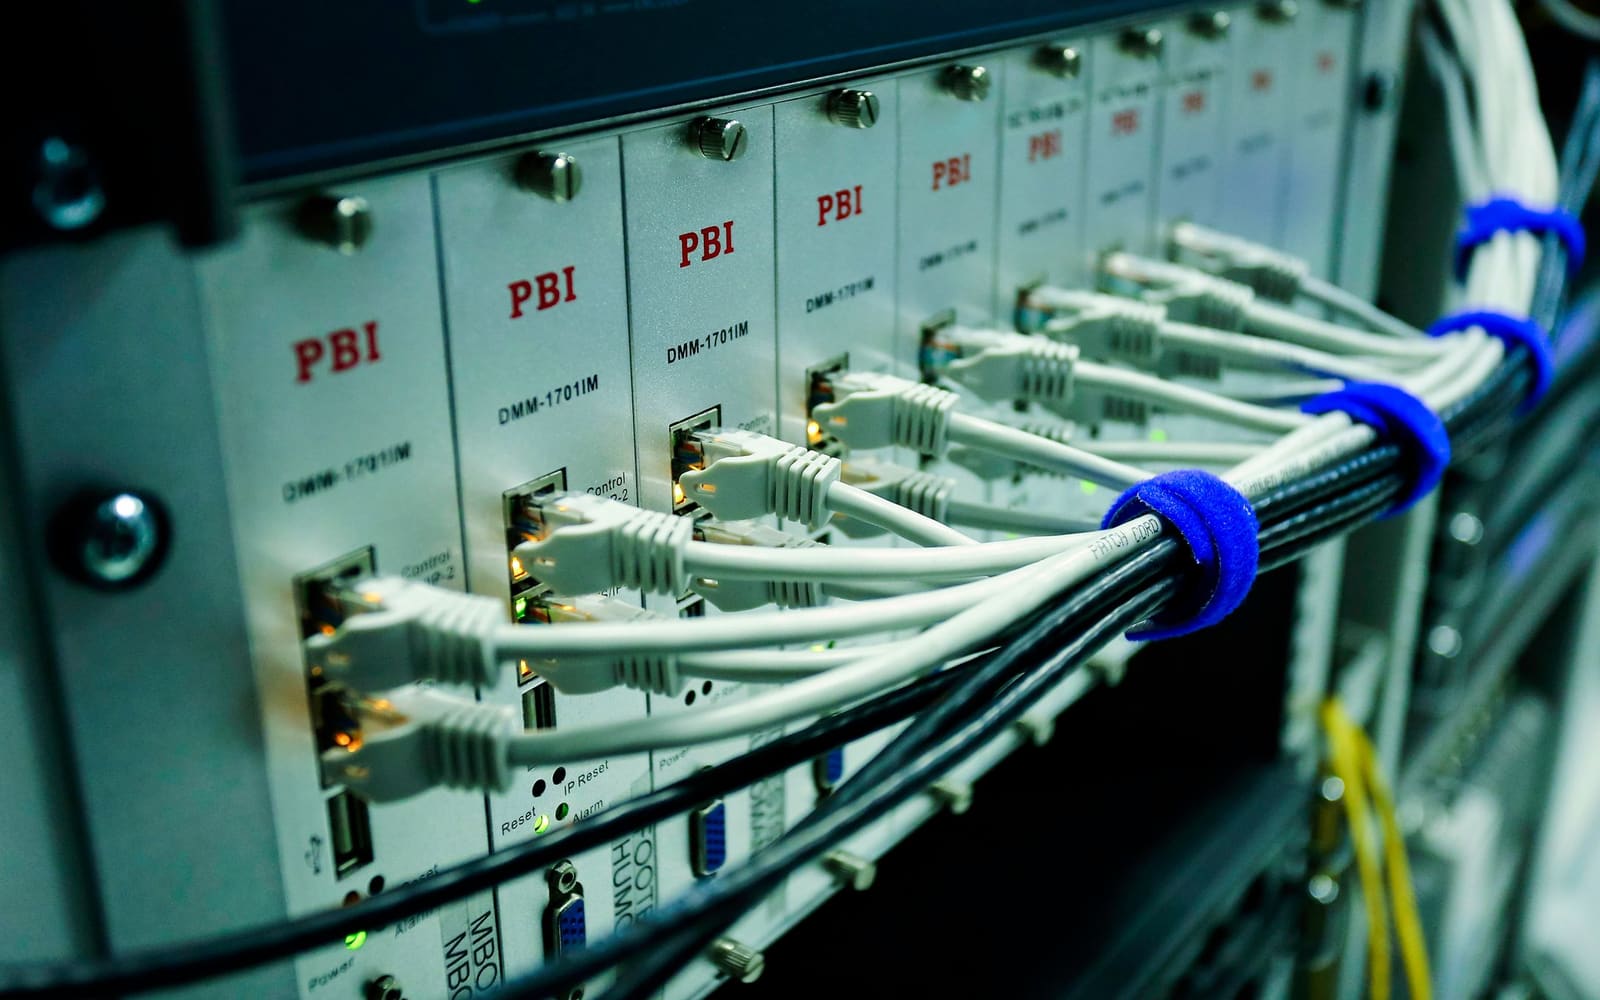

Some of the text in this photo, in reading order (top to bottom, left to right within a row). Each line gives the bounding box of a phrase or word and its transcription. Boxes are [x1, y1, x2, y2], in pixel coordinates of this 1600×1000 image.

[931, 153, 971, 191] PBI
[817, 185, 863, 226] PBI
[679, 220, 735, 268] PBI
[508, 265, 577, 319] PBI
[806, 276, 875, 313] DMM-1701IM
[293, 321, 383, 383] PBI
[667, 320, 750, 364] DMM-1701IM
[498, 374, 599, 425] DMM-1701IM
[284, 441, 412, 503] DMM-1701IM
[587, 472, 626, 497] Control
[1088, 519, 1159, 559] PATCH CORD
[577, 760, 609, 787] Reset
[501, 806, 536, 835] Reset
[573, 800, 604, 824] Alarm
[470, 910, 498, 991] MBO
[308, 957, 354, 991] Power
